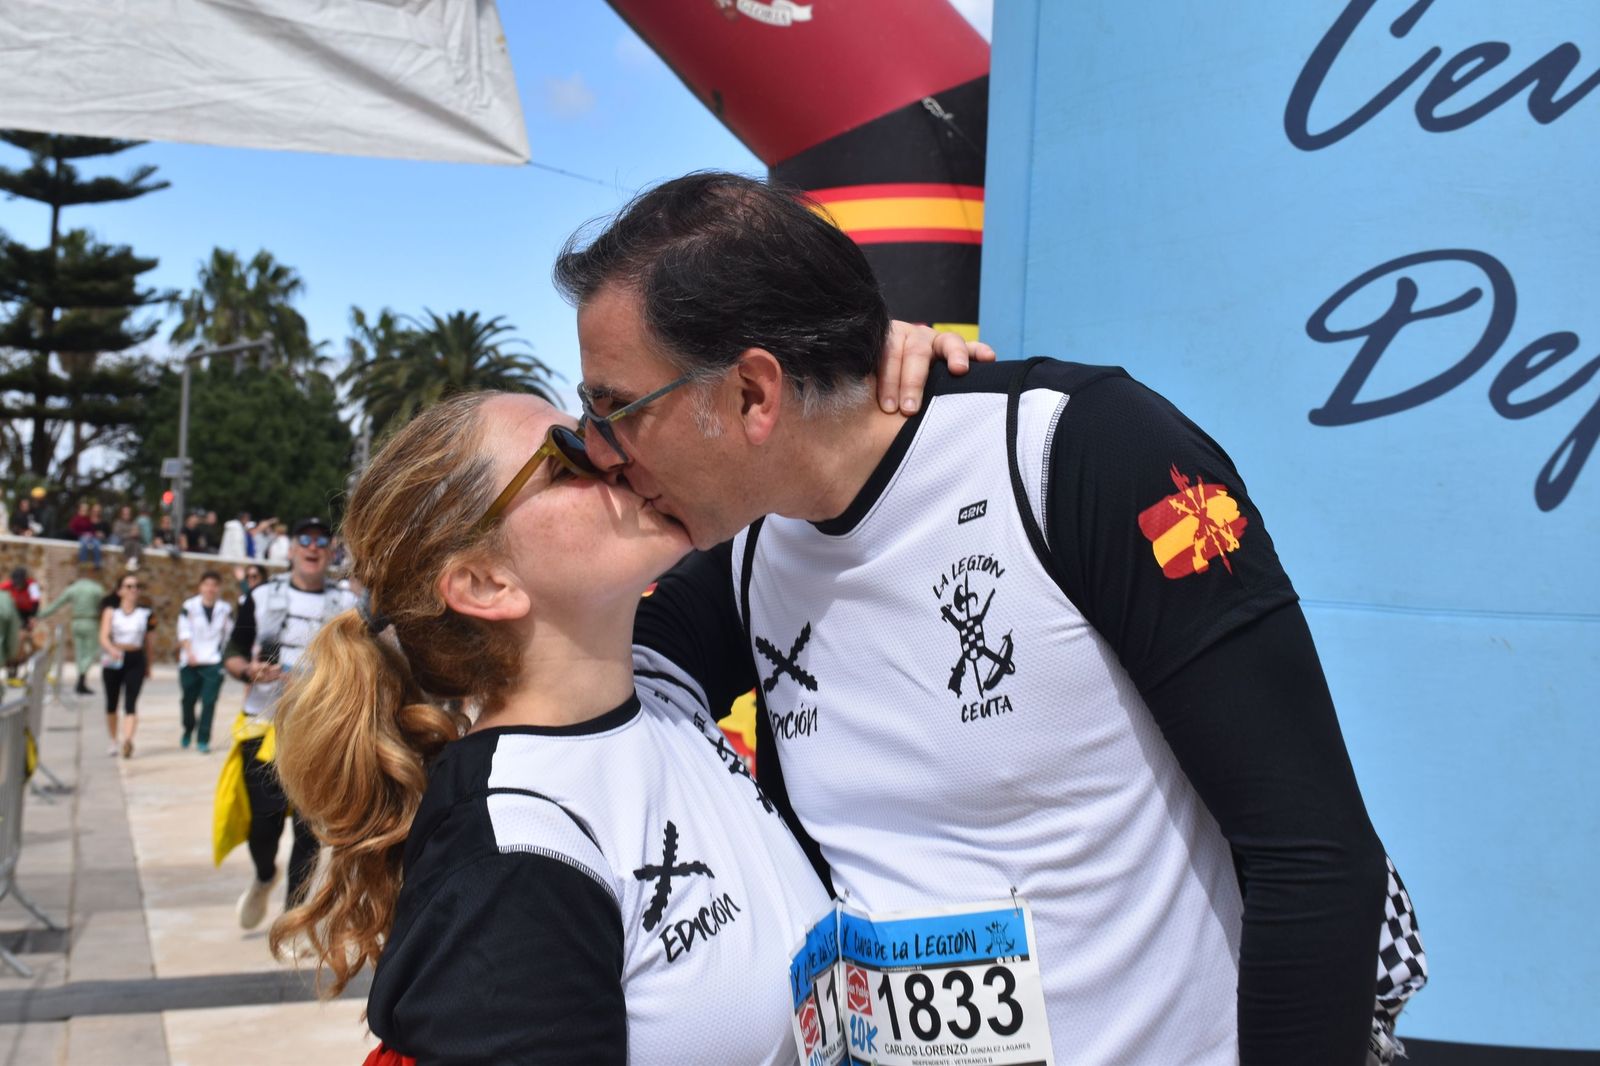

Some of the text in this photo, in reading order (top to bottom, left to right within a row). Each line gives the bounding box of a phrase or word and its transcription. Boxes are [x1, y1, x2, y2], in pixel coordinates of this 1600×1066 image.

[933, 553, 1005, 600] LA LEGIÓN
[770, 702, 818, 740] DICIÓN
[961, 695, 1013, 723] CEUTA
[659, 892, 741, 963] EDICIÓN
[914, 928, 977, 959] LEGIÓN
[877, 966, 1024, 1042] 1833
[850, 1014, 878, 1054] 20K
[884, 1042, 917, 1056] CARLOS
[918, 1043, 968, 1057] LORENZO
